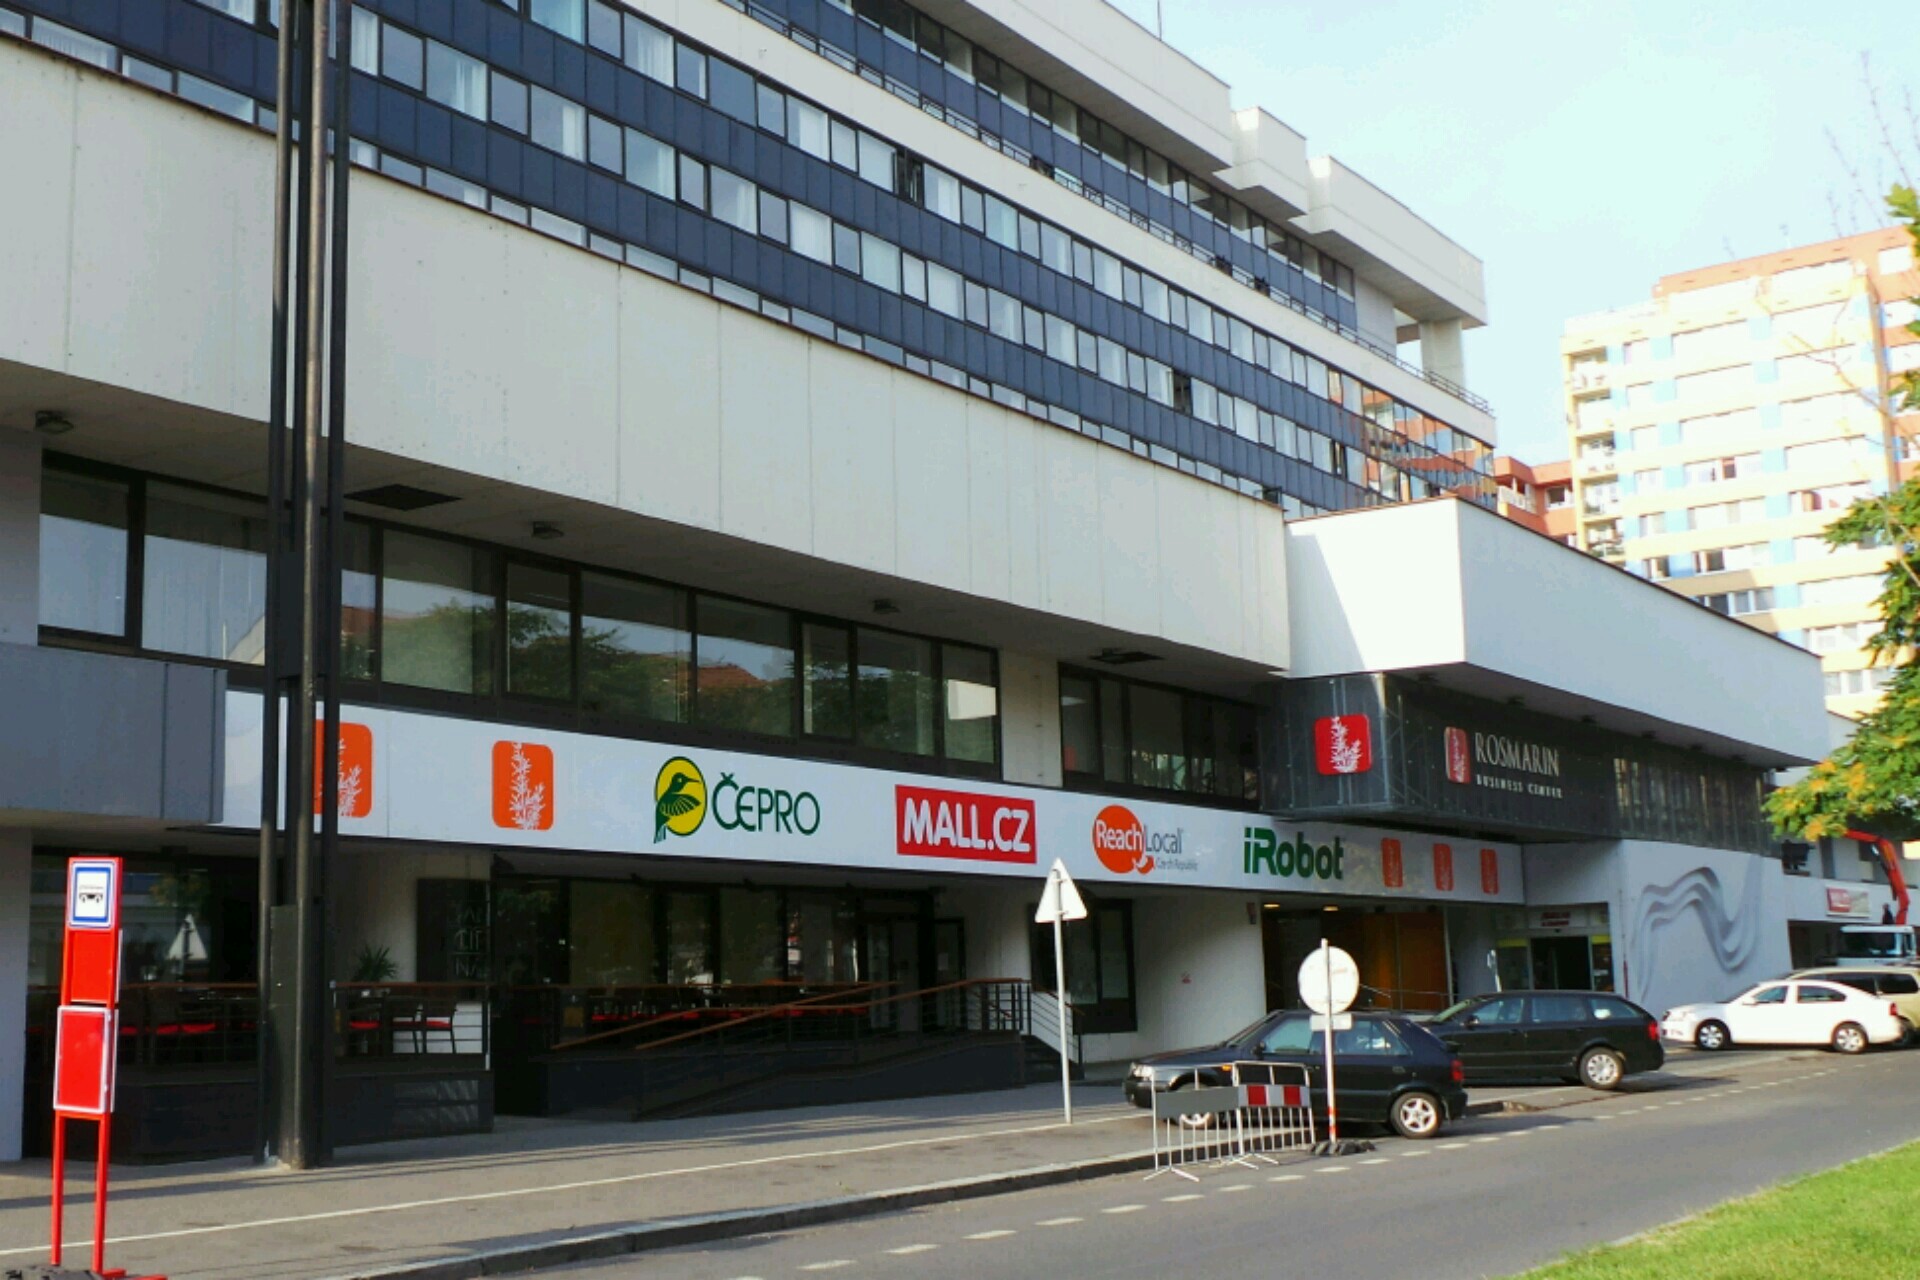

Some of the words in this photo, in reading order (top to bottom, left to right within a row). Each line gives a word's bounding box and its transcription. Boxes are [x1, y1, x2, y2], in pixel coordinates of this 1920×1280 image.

[1475, 732, 1560, 777] ROSMARIN
[712, 771, 820, 836] ČEPRO
[1476, 774, 1524, 793] BUSINESS
[903, 797, 1031, 853] MALL.CZ
[1243, 826, 1344, 880] iRobot
